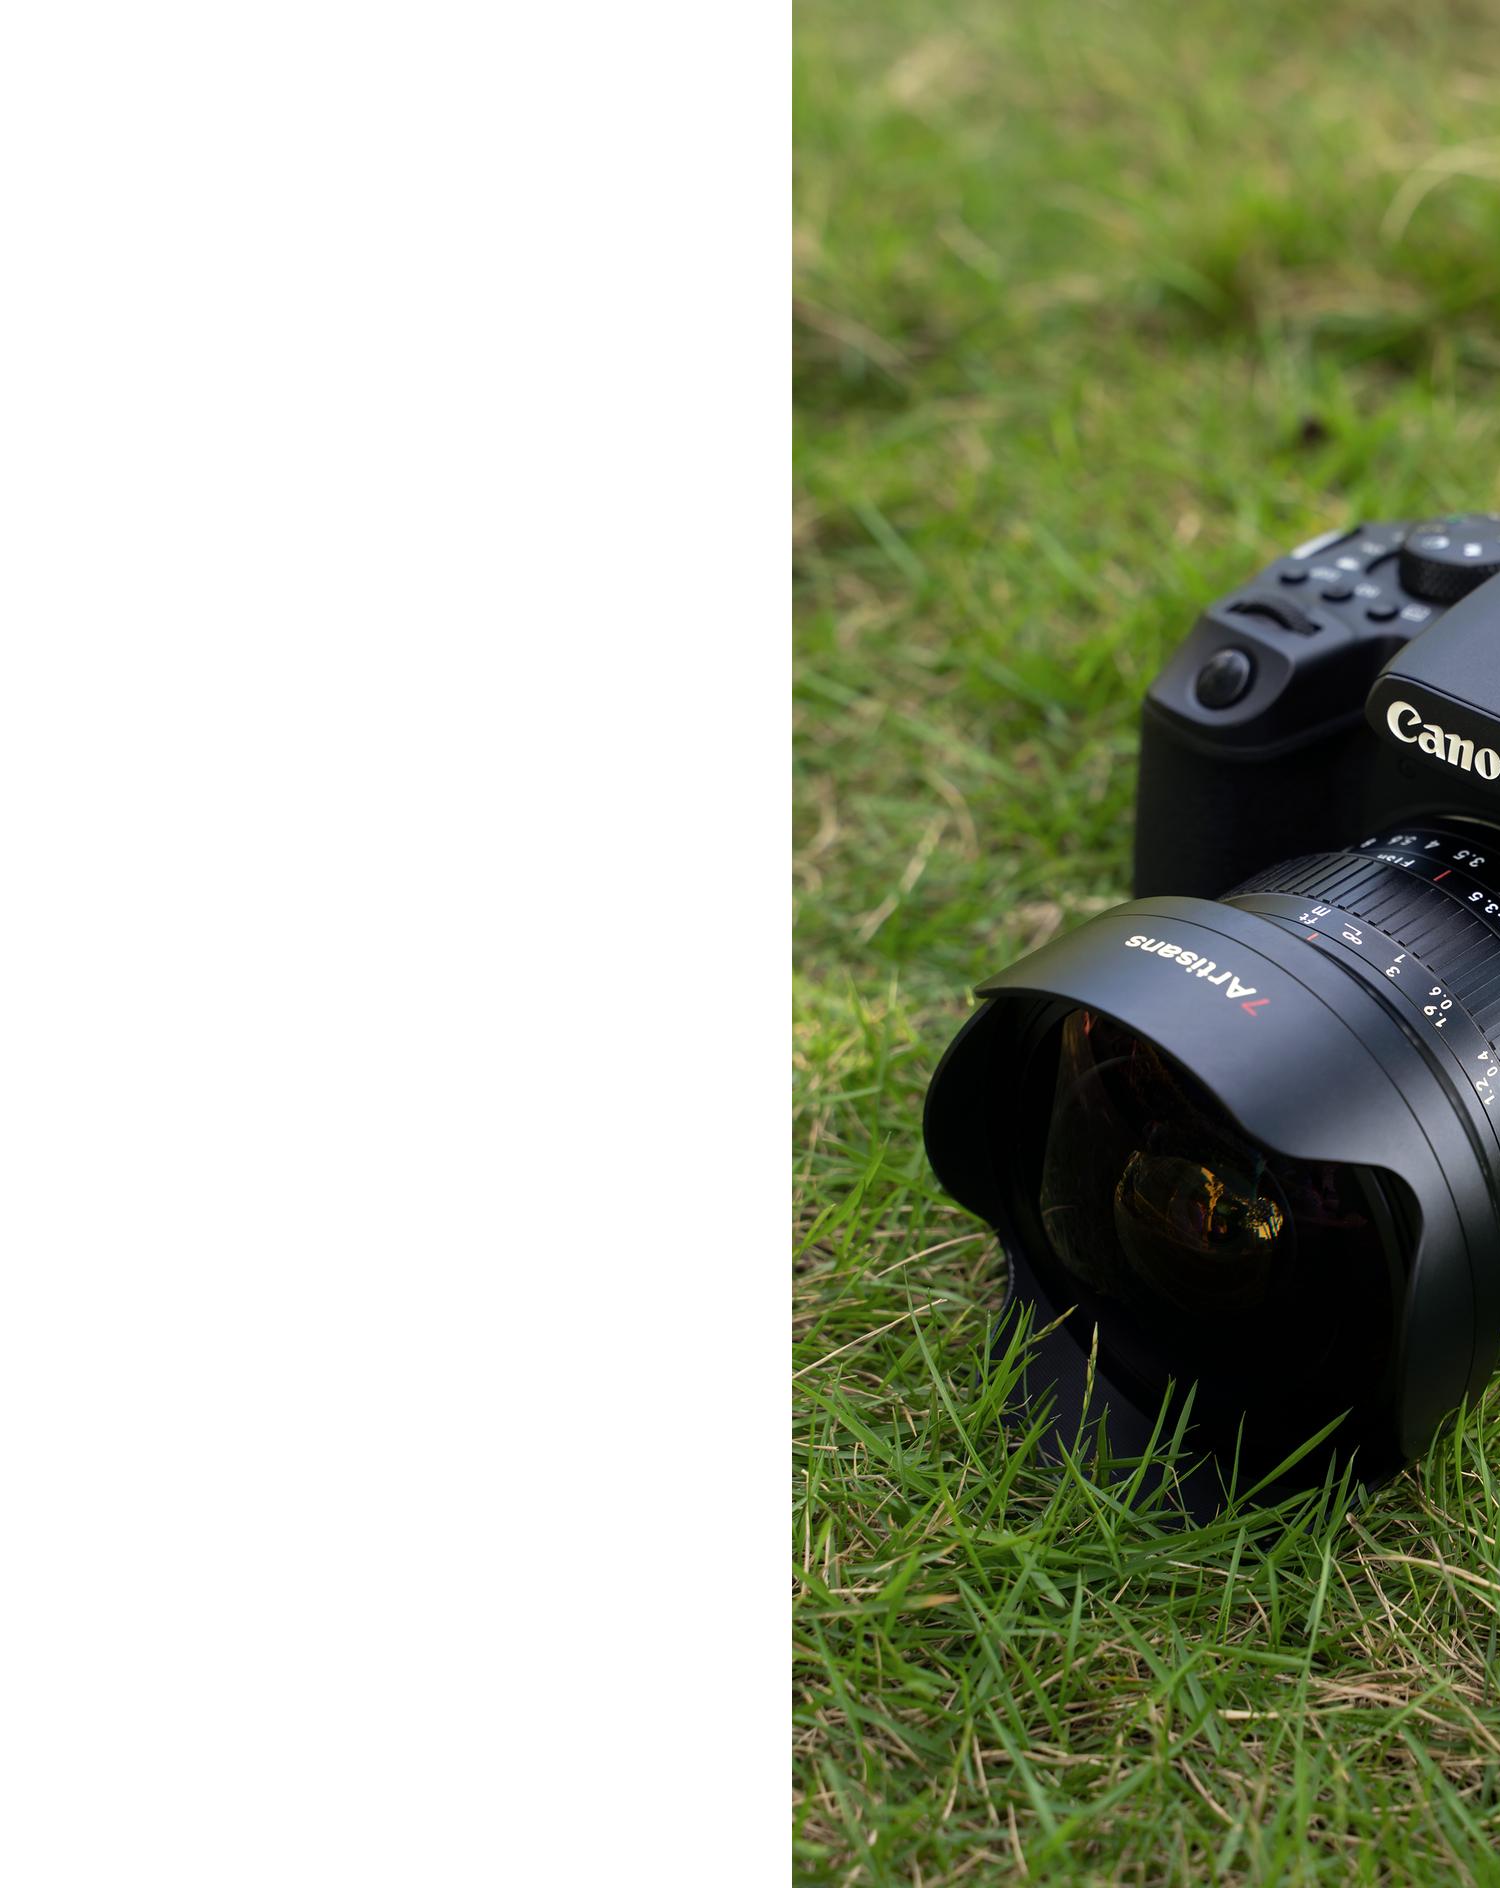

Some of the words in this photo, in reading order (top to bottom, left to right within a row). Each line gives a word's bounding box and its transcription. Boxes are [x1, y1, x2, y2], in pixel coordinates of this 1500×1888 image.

[1452, 849, 1486, 868] 3.5
[1299, 912, 1318, 925] ft
[1311, 905, 1332, 917] m
[1393, 953, 1406, 963] 1
[1124, 935, 1271, 1018] 7Artisans
[1385, 966, 1401, 978] 3
[1428, 986, 1453, 1010] 0.6
[1423, 1005, 1447, 1028] 1.9
[1477, 1050, 1498, 1077] 0.4
[1475, 1077, 1496, 1105] 1.2
